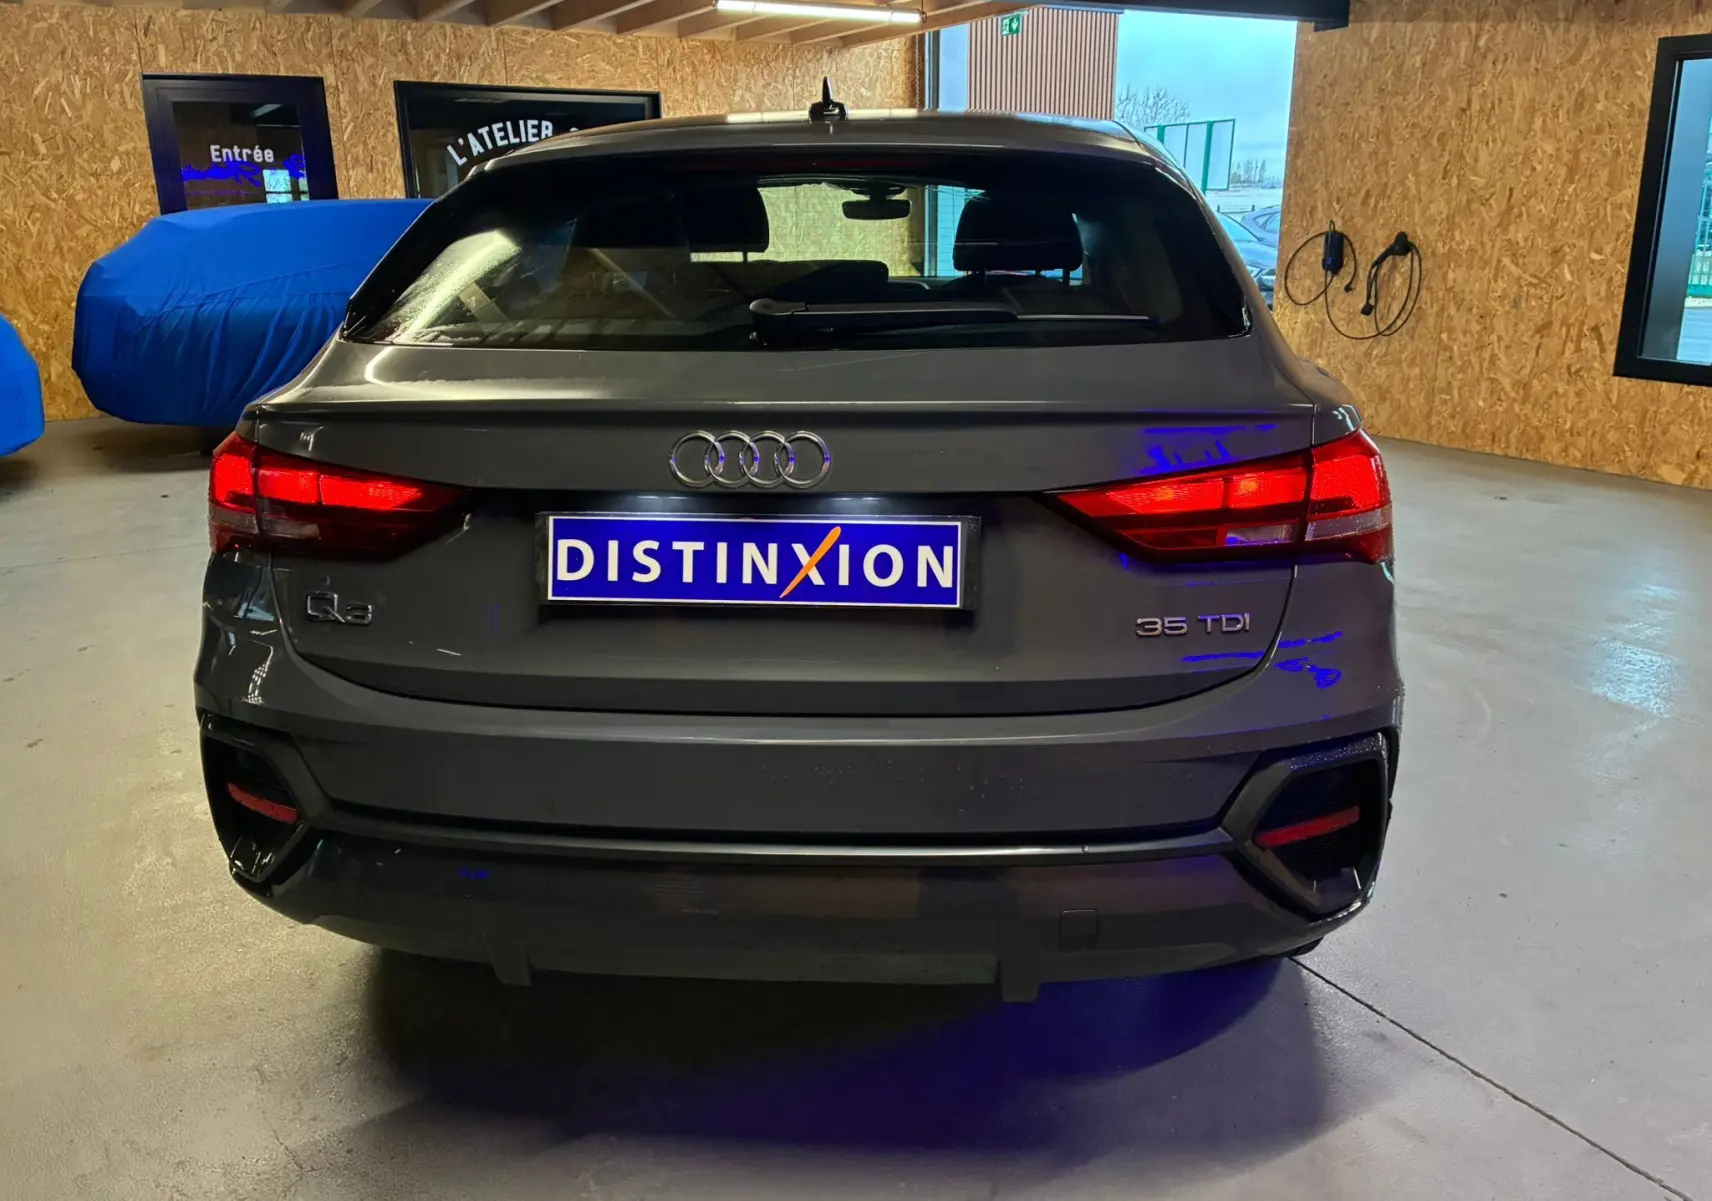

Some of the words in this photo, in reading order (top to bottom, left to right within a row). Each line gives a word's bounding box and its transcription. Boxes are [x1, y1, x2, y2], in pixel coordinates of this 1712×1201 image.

[209, 144, 275, 163] Entrée
[446, 119, 554, 166] L'ATELIER
[556, 527, 954, 598] DISTINXION
[305, 590, 373, 624] Q3
[1136, 616, 1188, 636] 35
[1197, 613, 1250, 633] TDI
